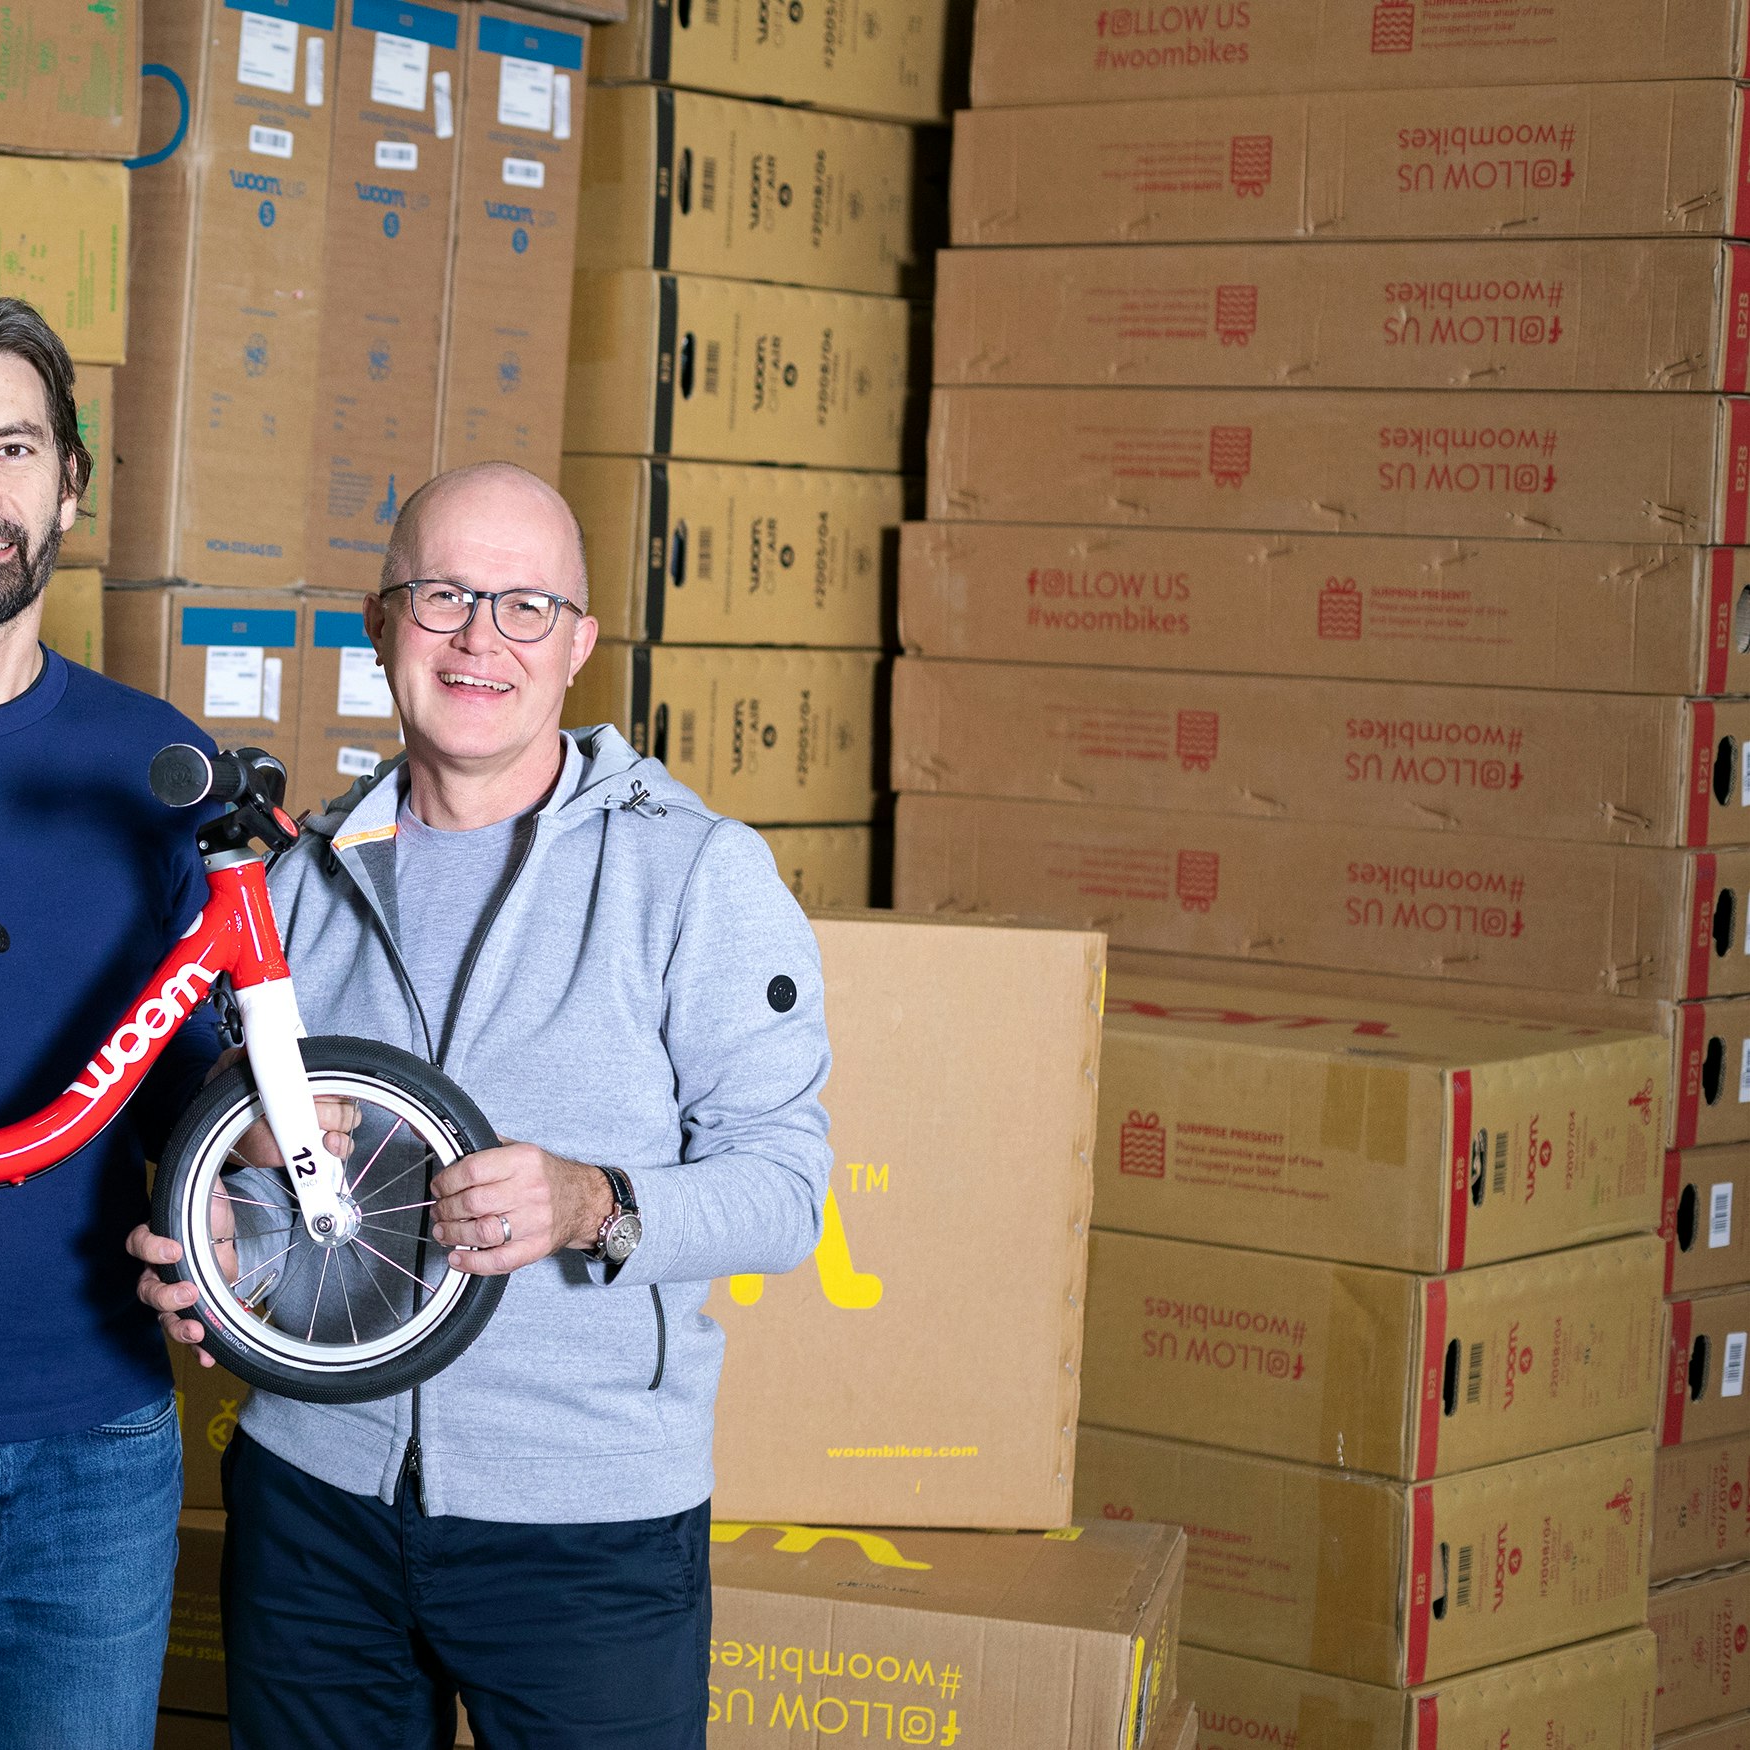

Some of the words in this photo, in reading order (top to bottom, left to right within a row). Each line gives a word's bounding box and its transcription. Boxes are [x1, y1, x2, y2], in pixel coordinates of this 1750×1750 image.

[1217, 2, 1251, 32] US
[1094, 37, 1249, 71] #woombikes
[1397, 124, 1577, 156] #woombikes
[1397, 162, 1433, 194] US
[1385, 280, 1565, 312] #woombikes
[1383, 315, 1421, 346] US
[1736, 292, 1749, 340] B2B
[1379, 427, 1558, 458] #woombikes
[1378, 462, 1416, 492] US
[1734, 444, 1747, 492] B2B
[1153, 572, 1190, 601] US
[1026, 603, 1190, 635] #woombikes
[1716, 602, 1729, 649] B2B
[1346, 717, 1524, 754] #woombikes
[1345, 752, 1383, 782] US
[1697, 748, 1710, 795] B2B
[1346, 861, 1525, 902] #woombikes
[1345, 897, 1383, 926] US
[1698, 900, 1711, 948] B2B
[1686, 1048, 1700, 1097] B2B
[291, 1146, 317, 1179] 12
[846, 1163, 890, 1194] TM
[1455, 1156, 1465, 1191] B2B
[1143, 1295, 1307, 1347] #woombikes
[222, 1329, 250, 1355] EDITION
[1141, 1328, 1178, 1361] US
[1427, 1367, 1438, 1400] B2B
[1674, 1348, 1687, 1396] B2B
[827, 1444, 979, 1459] woombikes.com
[1416, 1572, 1427, 1606] B2B
[709, 1638, 963, 1700] #woombikes
[708, 1685, 754, 1726] US
